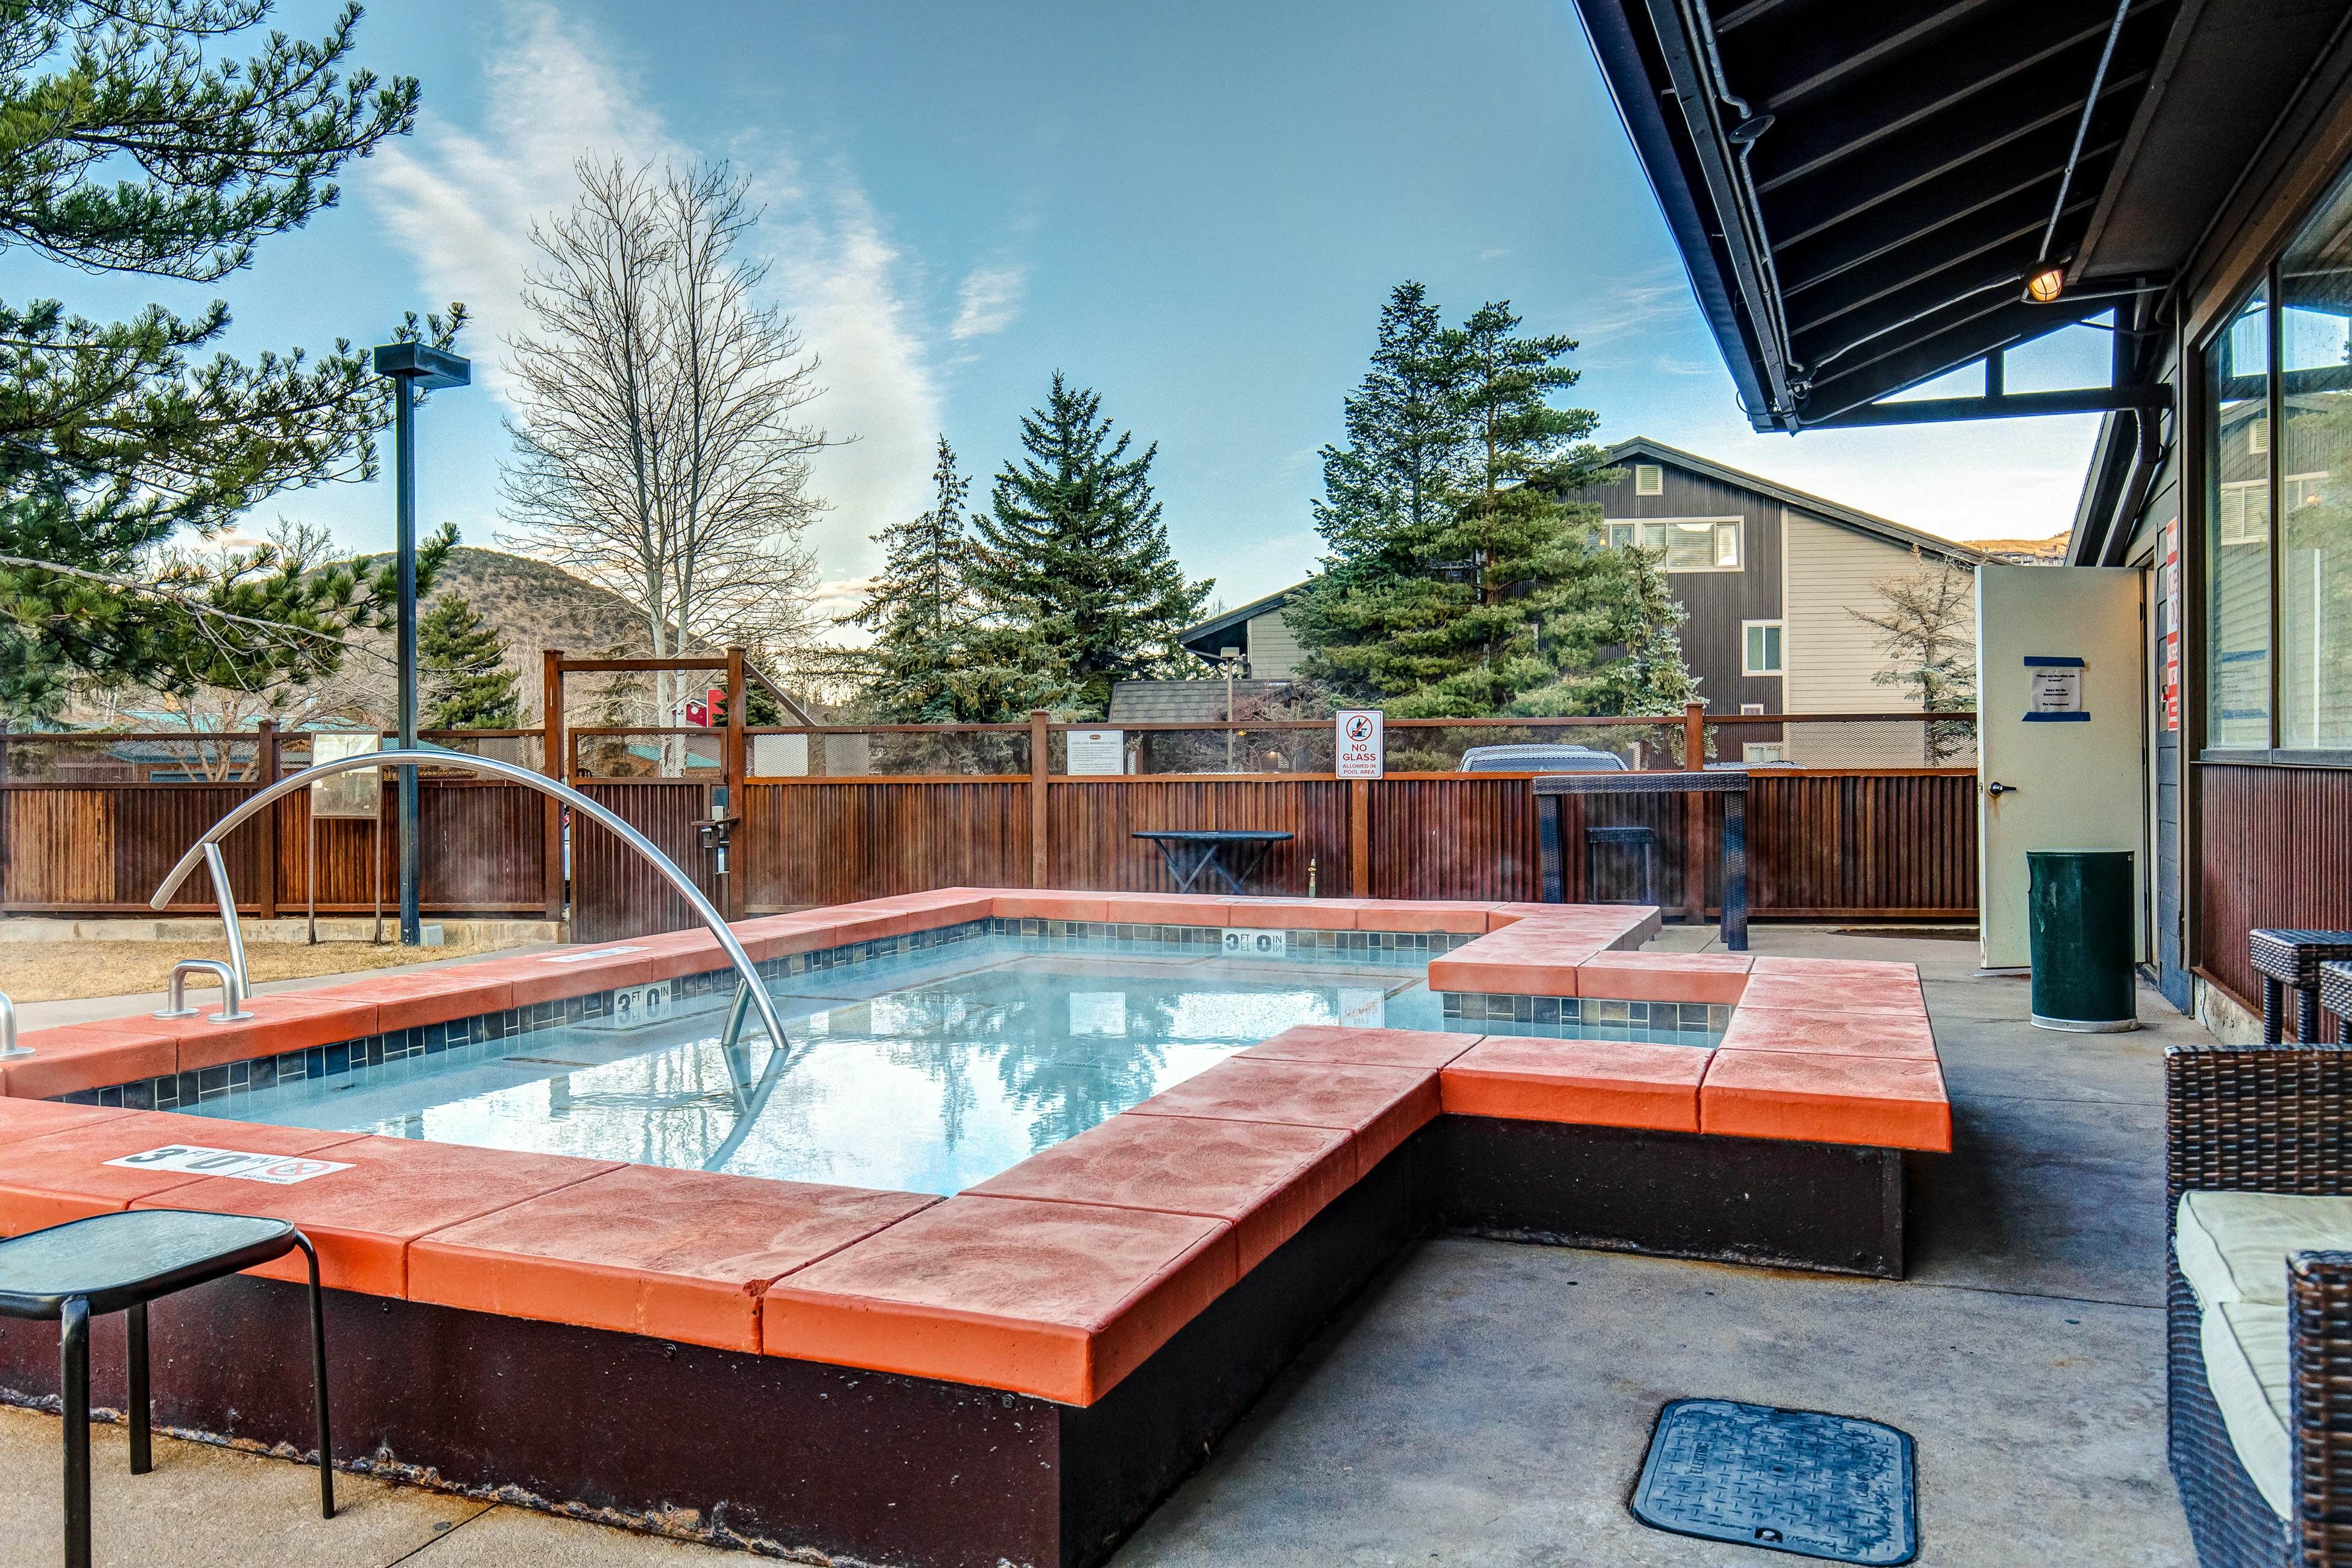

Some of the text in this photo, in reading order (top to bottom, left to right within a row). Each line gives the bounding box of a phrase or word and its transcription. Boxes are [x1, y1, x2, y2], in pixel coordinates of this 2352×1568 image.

[1241, 934, 1250, 942] FT
[1272, 935, 1282, 944] IN
[632, 990, 641, 1002] FT
[660, 985, 669, 997] IN
[124, 1148, 188, 1163] 3
[185, 1155, 251, 1169] 0
[1689, 1441, 1710, 1475] ELECTRIC
